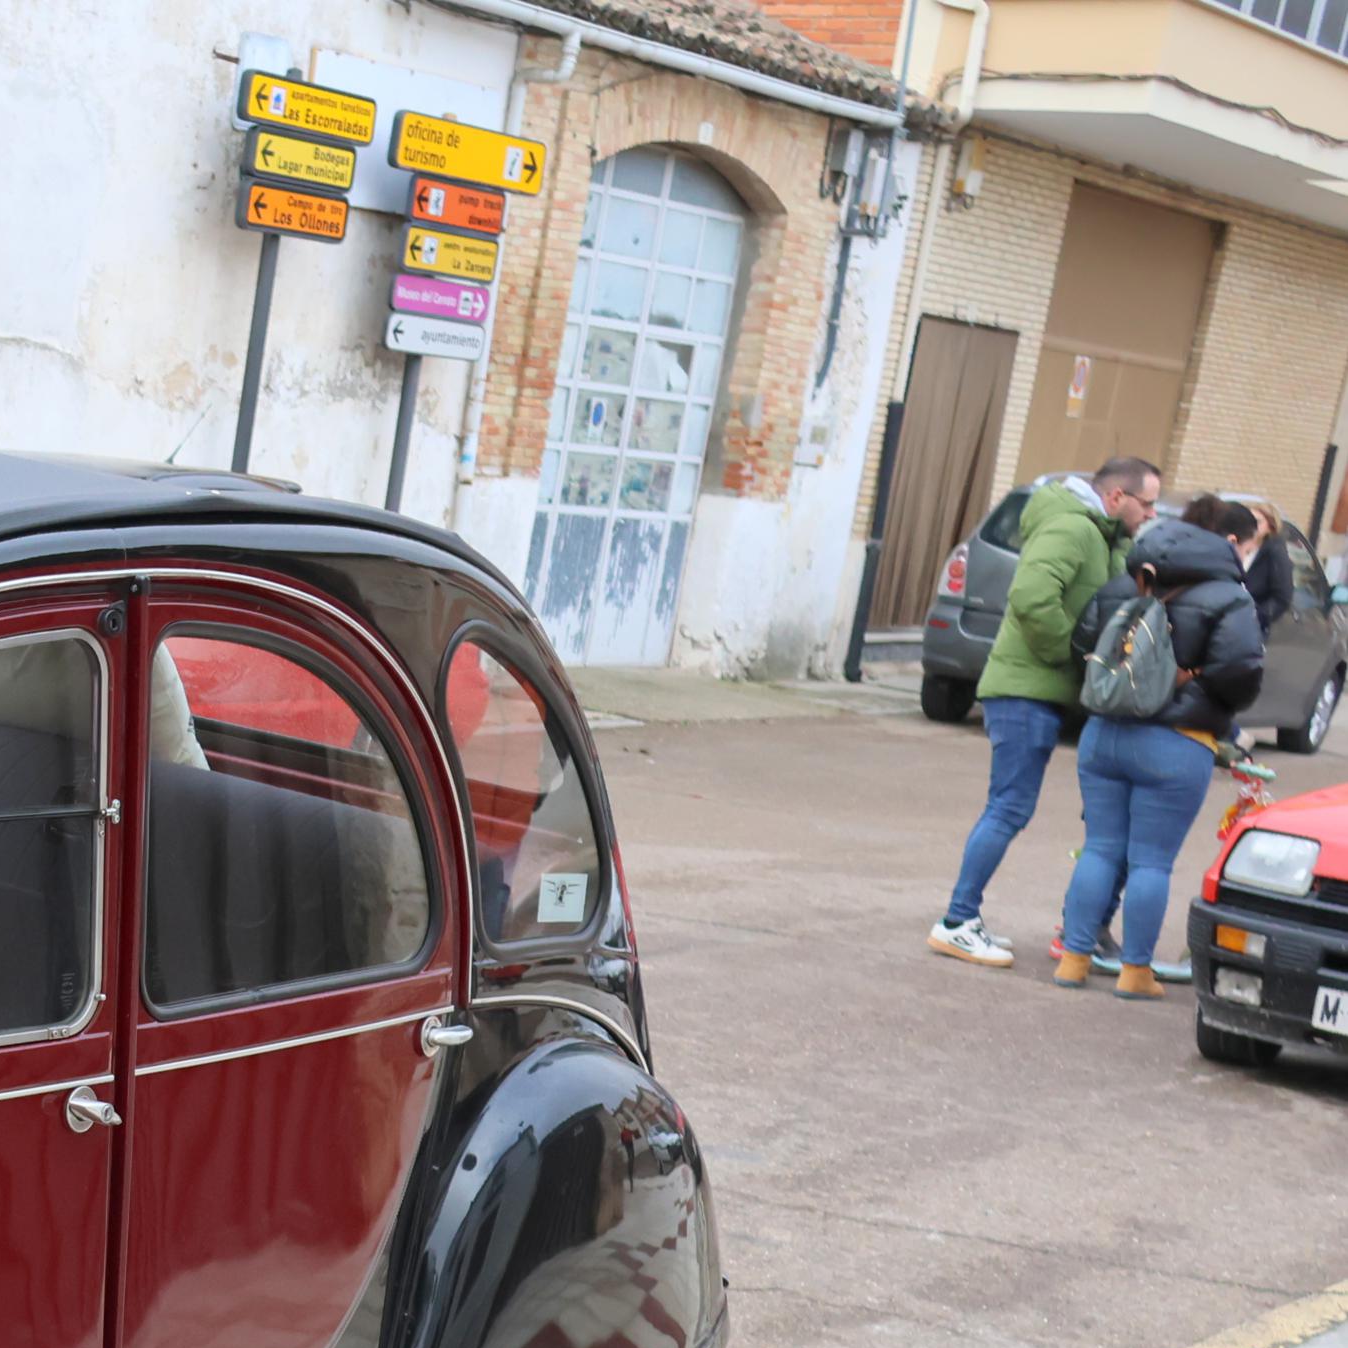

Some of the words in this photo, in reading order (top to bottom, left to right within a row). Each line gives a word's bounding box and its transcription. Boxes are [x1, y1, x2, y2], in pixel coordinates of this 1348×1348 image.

[283, 106, 300, 121] Las
[407, 120, 443, 145] oficina
[446, 129, 461, 149] de
[313, 147, 350, 167] Bodegas
[404, 144, 447, 169] turismo
[277, 157, 303, 174] Lagar
[305, 164, 348, 183] municipal
[273, 207, 293, 225] Los
[299, 212, 340, 234] Ollones
[421, 330, 480, 349] ayuntamiento
